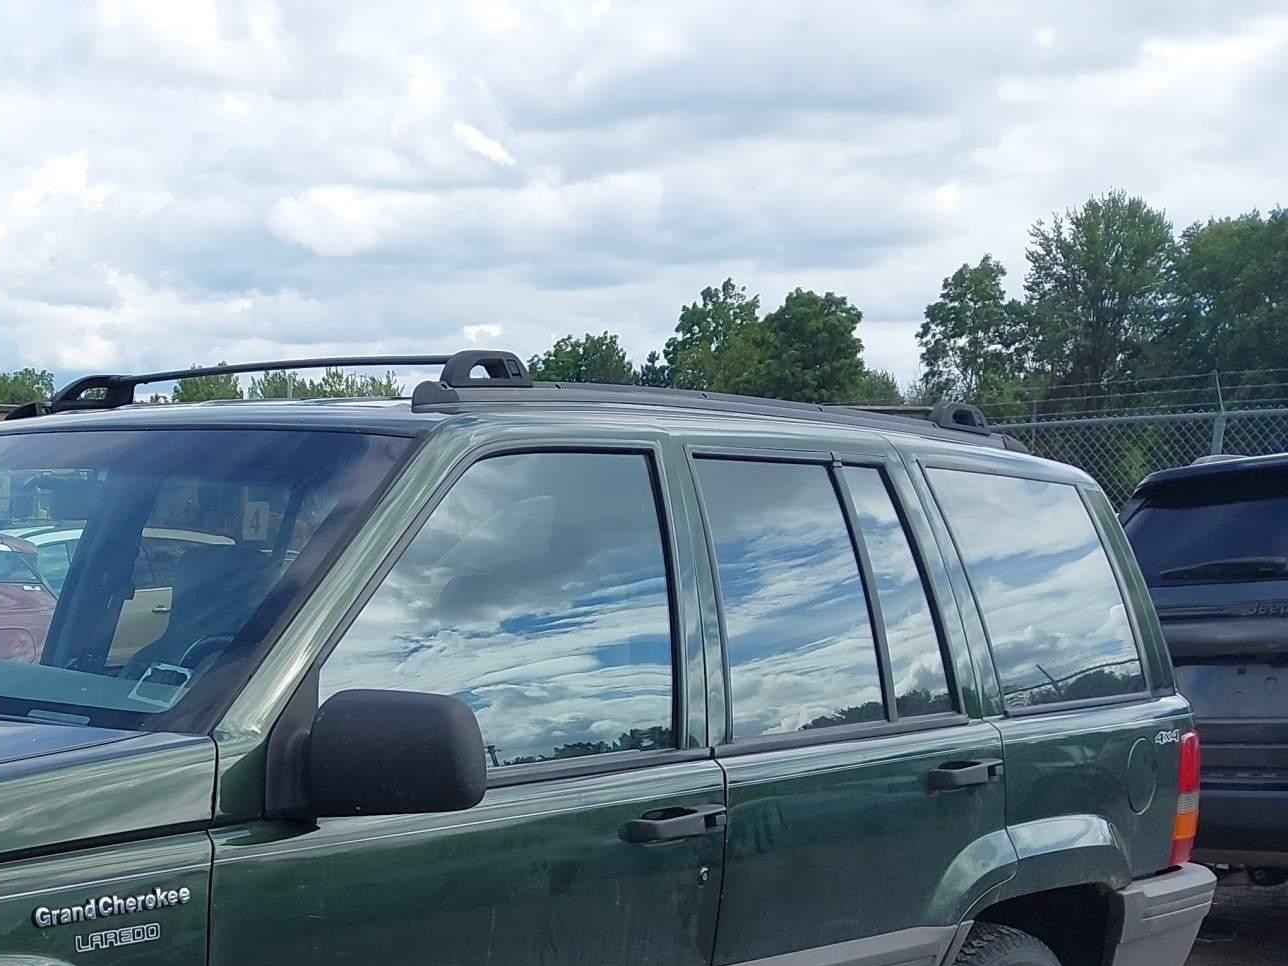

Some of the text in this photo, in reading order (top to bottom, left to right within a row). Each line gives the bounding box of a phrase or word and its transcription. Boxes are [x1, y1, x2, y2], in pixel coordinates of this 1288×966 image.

[34, 887, 191, 928] Grand Cherokee
[75, 923, 161, 953] LAREDO
